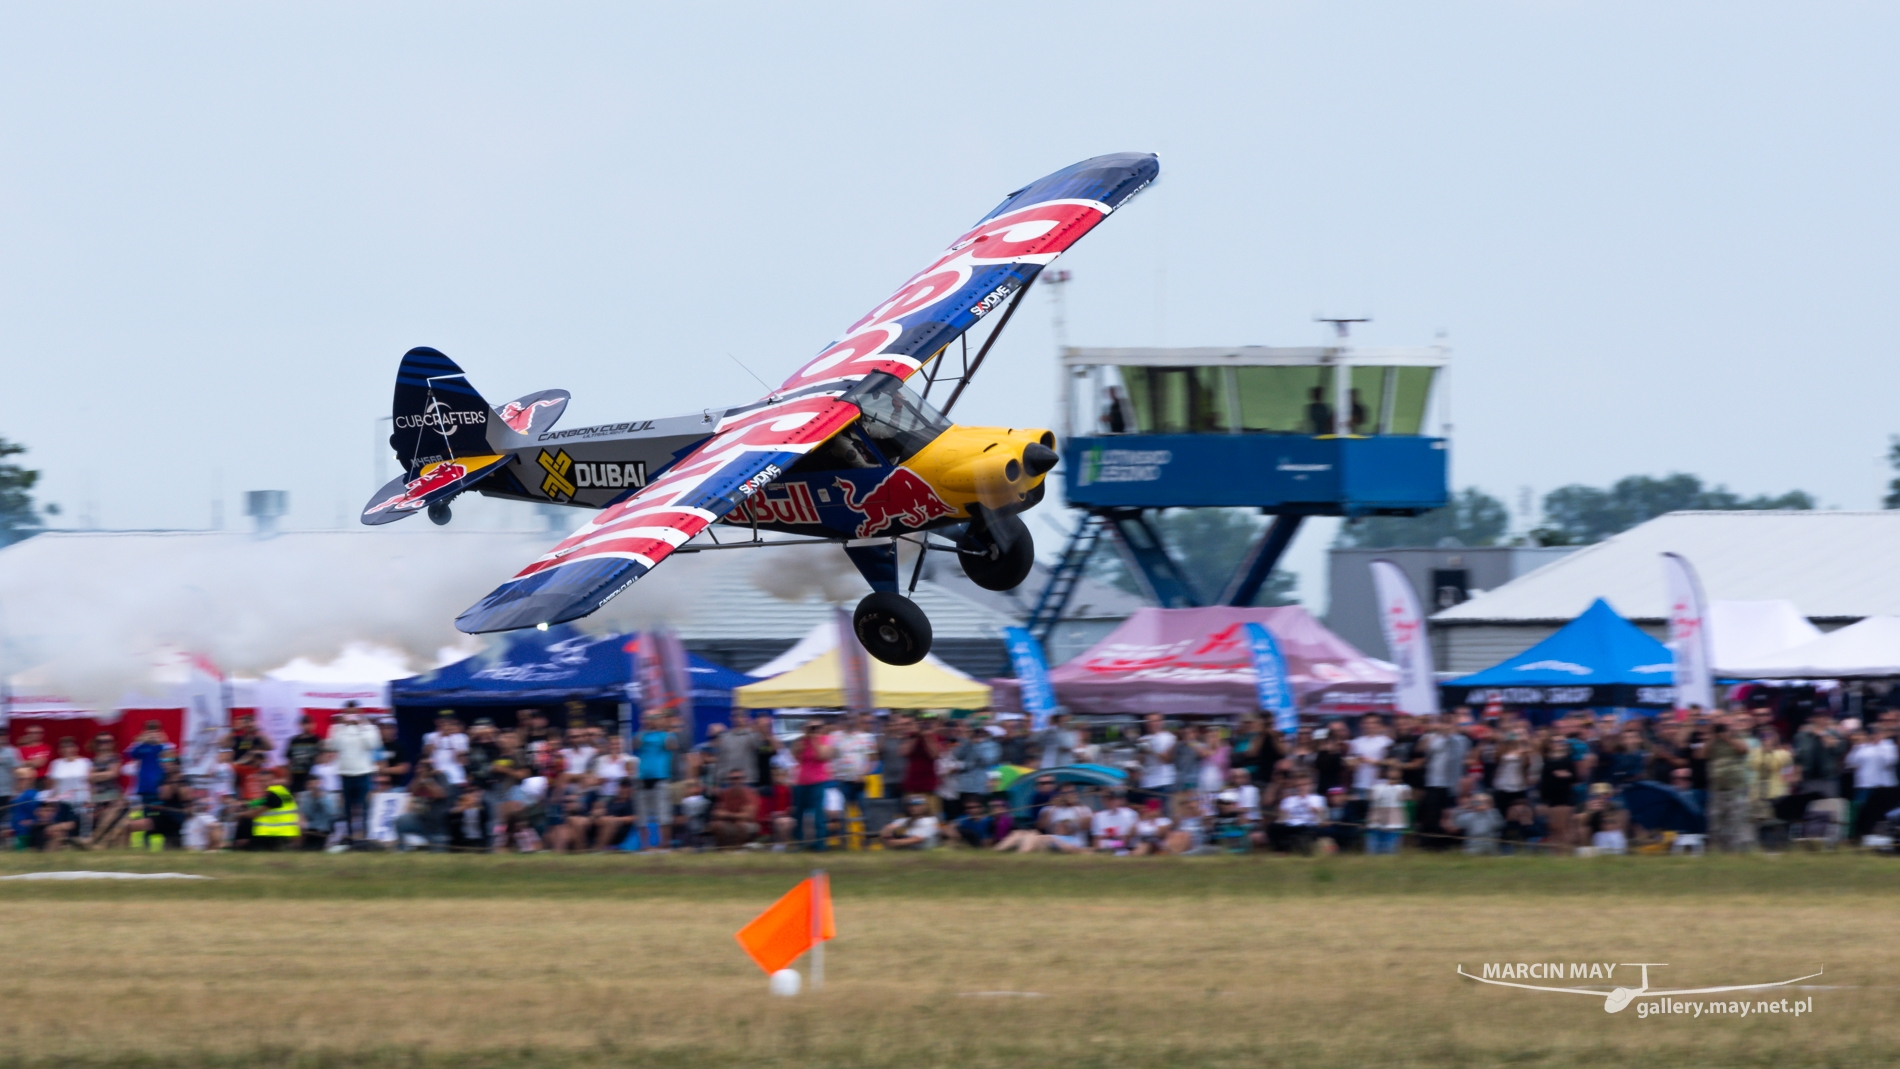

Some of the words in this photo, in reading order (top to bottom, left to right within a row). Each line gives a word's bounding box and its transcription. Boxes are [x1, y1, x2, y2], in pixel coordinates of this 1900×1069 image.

[970, 285, 1010, 316] SKYDIVE
[395, 411, 486, 428] CUBCRAFTERS
[538, 427, 600, 442] CARBON
[600, 422, 630, 432] CUB
[626, 420, 655, 433] UL
[582, 430, 625, 439] ULTRALIGHT
[574, 463, 646, 488] DUBAI
[739, 464, 780, 495] SKYDIVE
[744, 481, 822, 525] Bull
